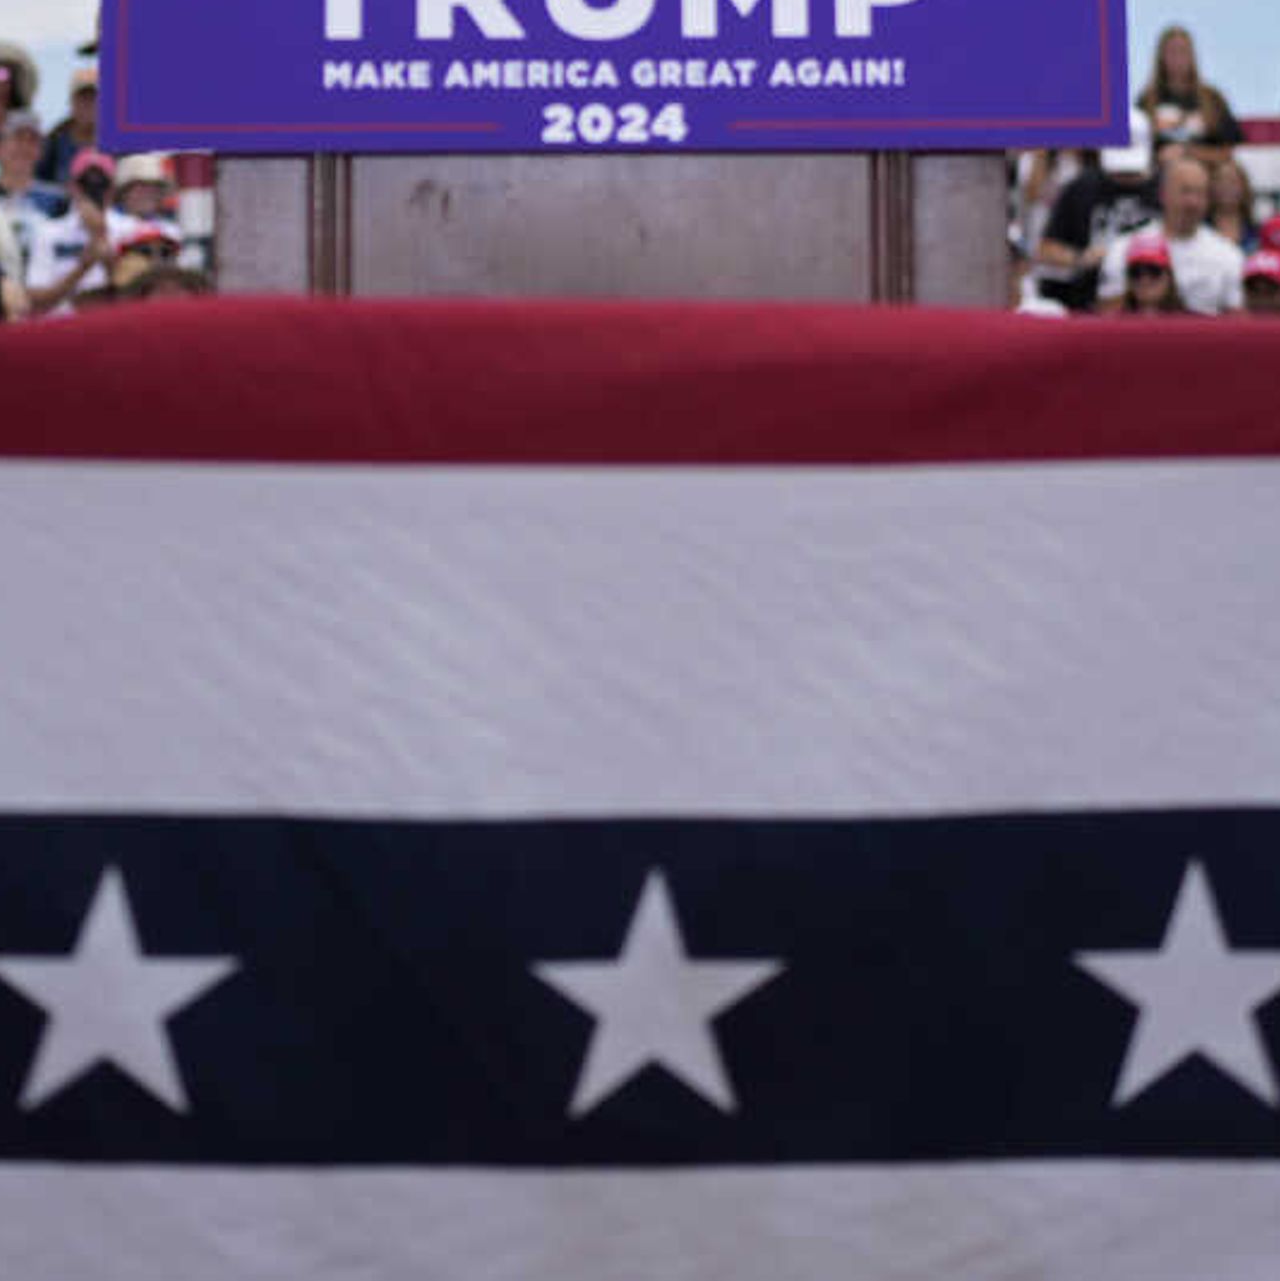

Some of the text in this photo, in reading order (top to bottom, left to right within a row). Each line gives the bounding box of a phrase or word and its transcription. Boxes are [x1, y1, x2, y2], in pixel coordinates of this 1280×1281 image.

[323, 58, 906, 89] MAKE AMERICA GREAT AGAIN!
[541, 102, 688, 144] 2024
